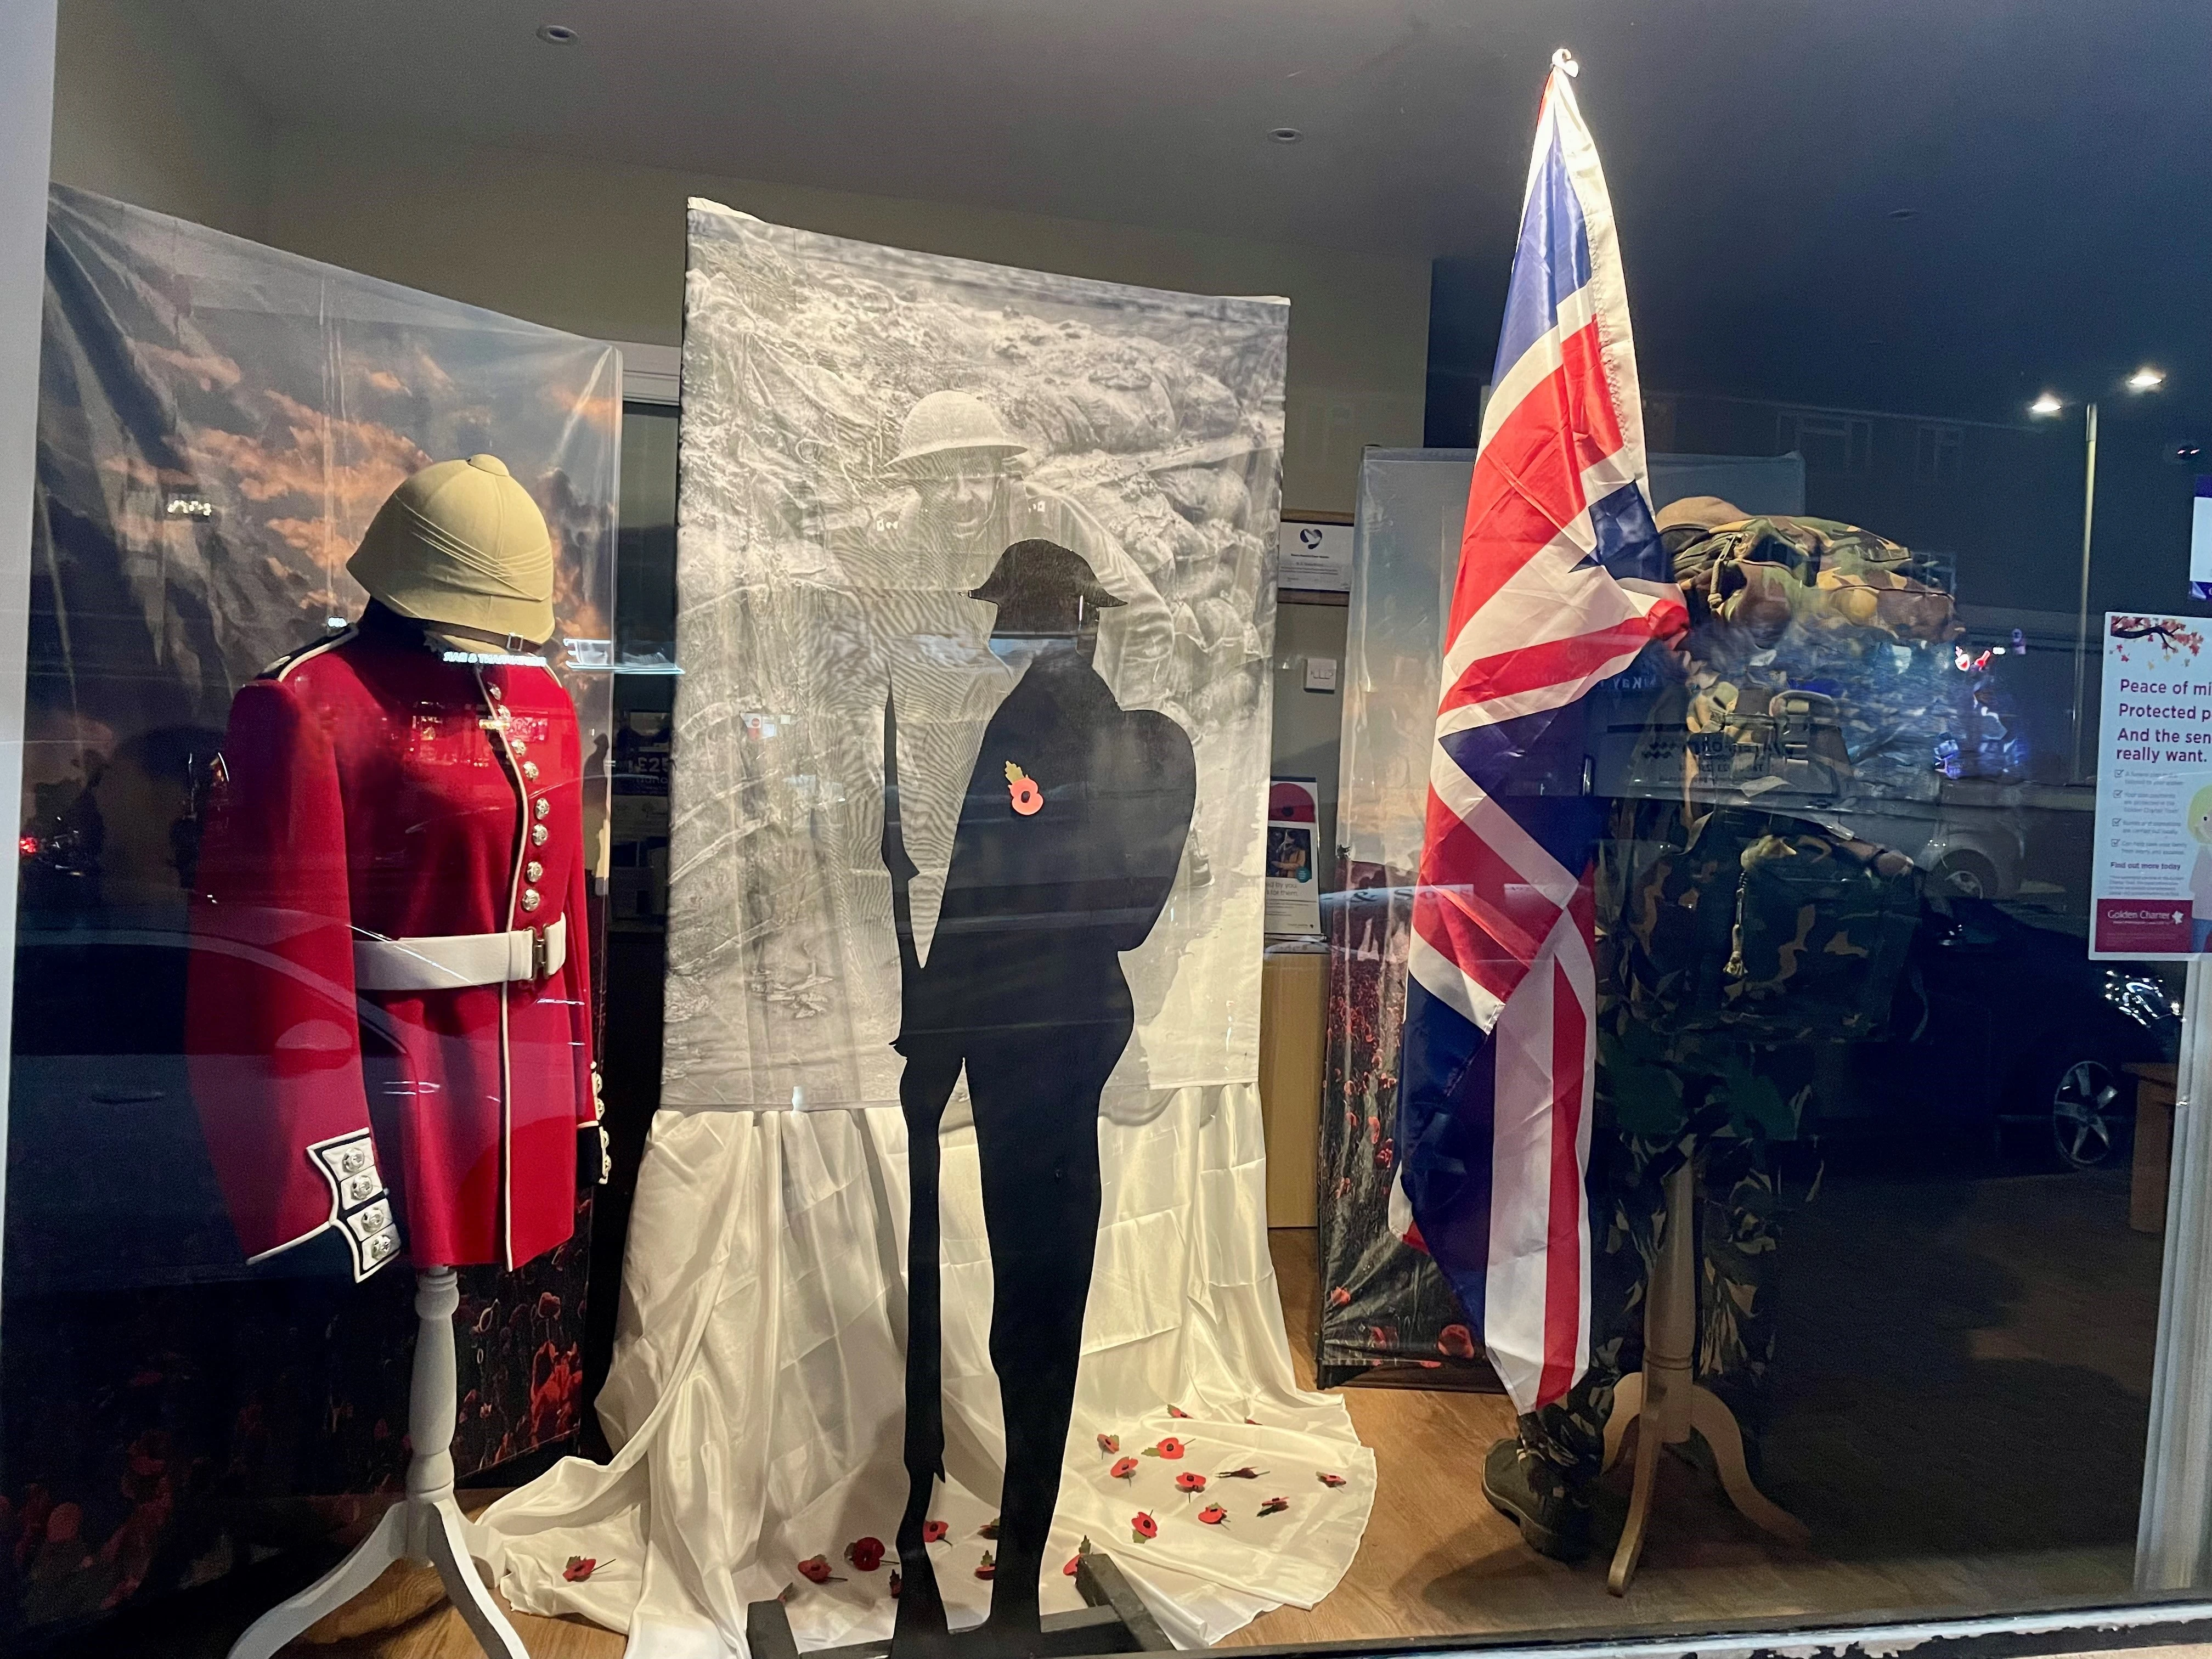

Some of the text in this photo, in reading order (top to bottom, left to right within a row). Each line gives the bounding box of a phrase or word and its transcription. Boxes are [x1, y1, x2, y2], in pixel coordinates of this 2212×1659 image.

[2120, 679, 2212, 696] Peace of mi
[2119, 703, 2196, 719] Protected
[2118, 728, 2211, 743] And the sen
[2117, 747, 2207, 763] really want.
[2108, 910, 2137, 919] Golden
